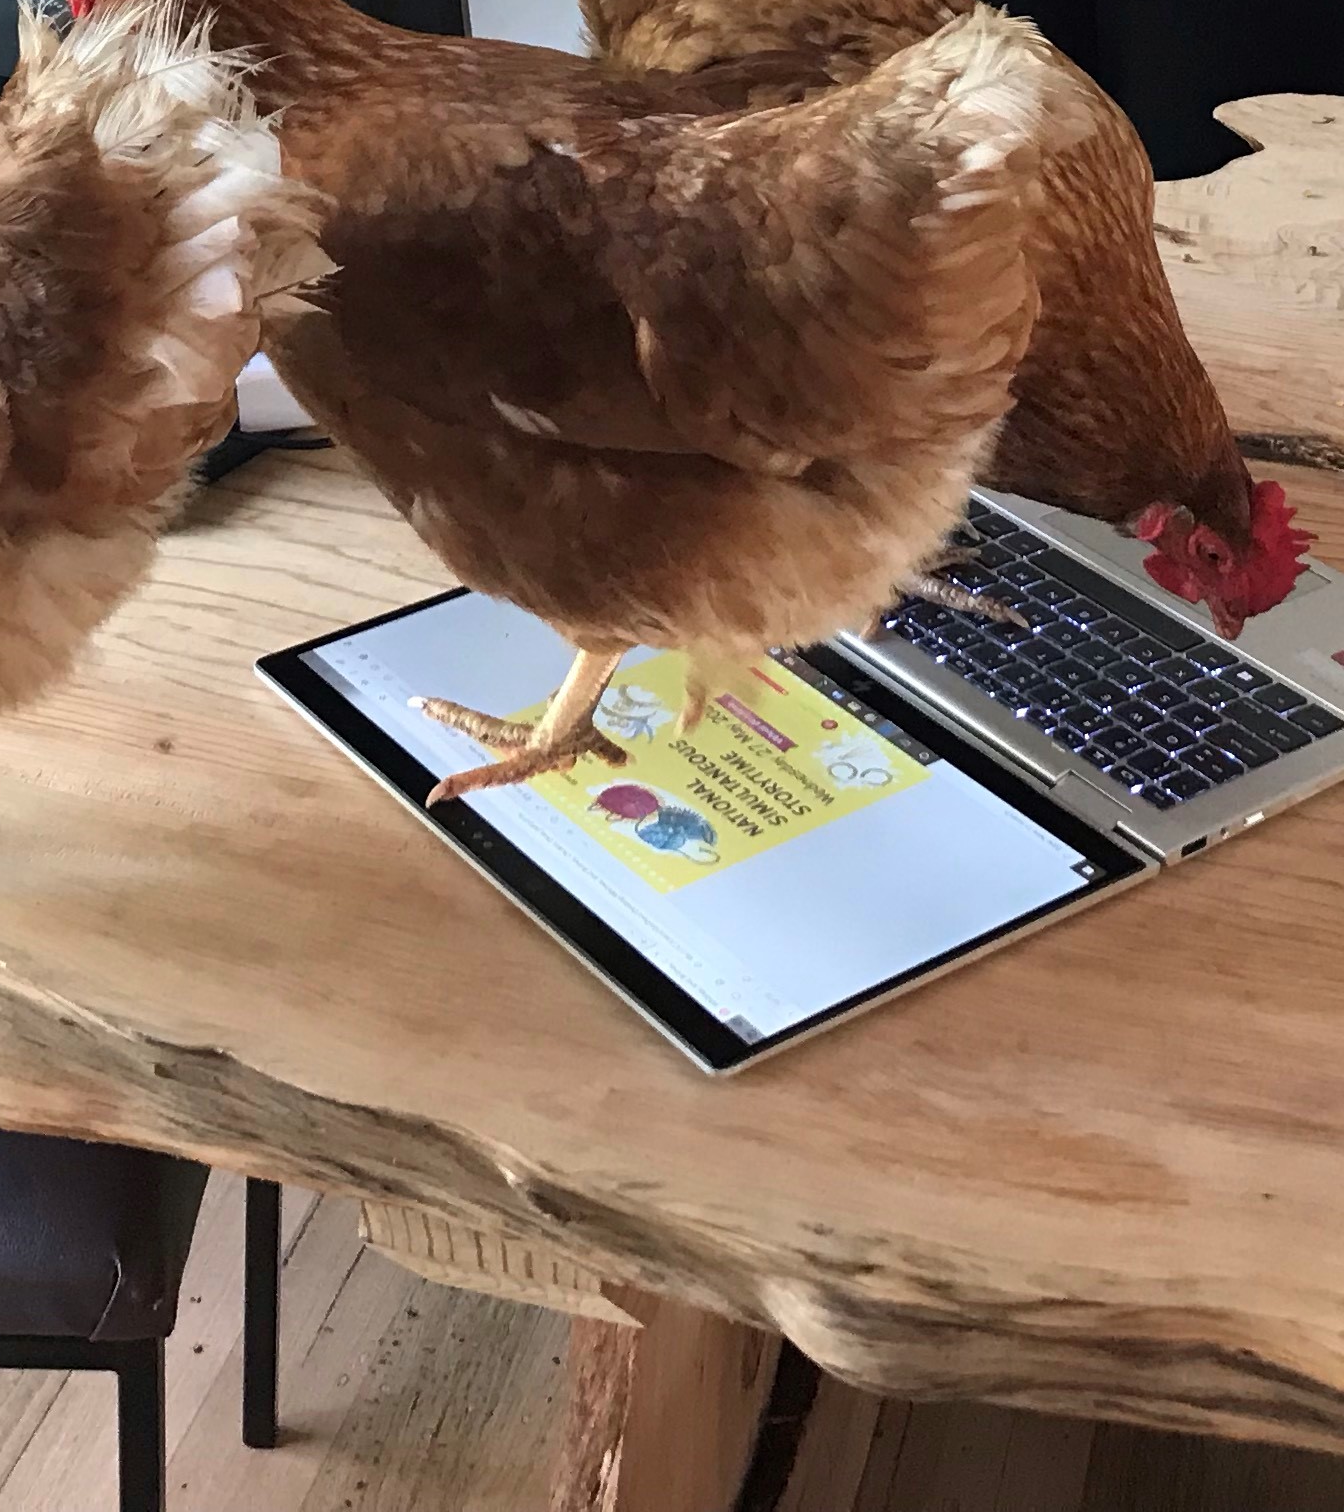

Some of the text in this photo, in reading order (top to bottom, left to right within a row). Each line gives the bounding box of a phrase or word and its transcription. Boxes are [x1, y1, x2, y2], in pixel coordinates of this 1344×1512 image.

[730, 723, 754, 744] May
[748, 743, 773, 758] 27
[668, 739, 789, 826] SIMULTANEOUS
[687, 777, 765, 837] NATIONAL
[719, 750, 812, 816] STORYTIME
[774, 755, 835, 806] Wednesday
